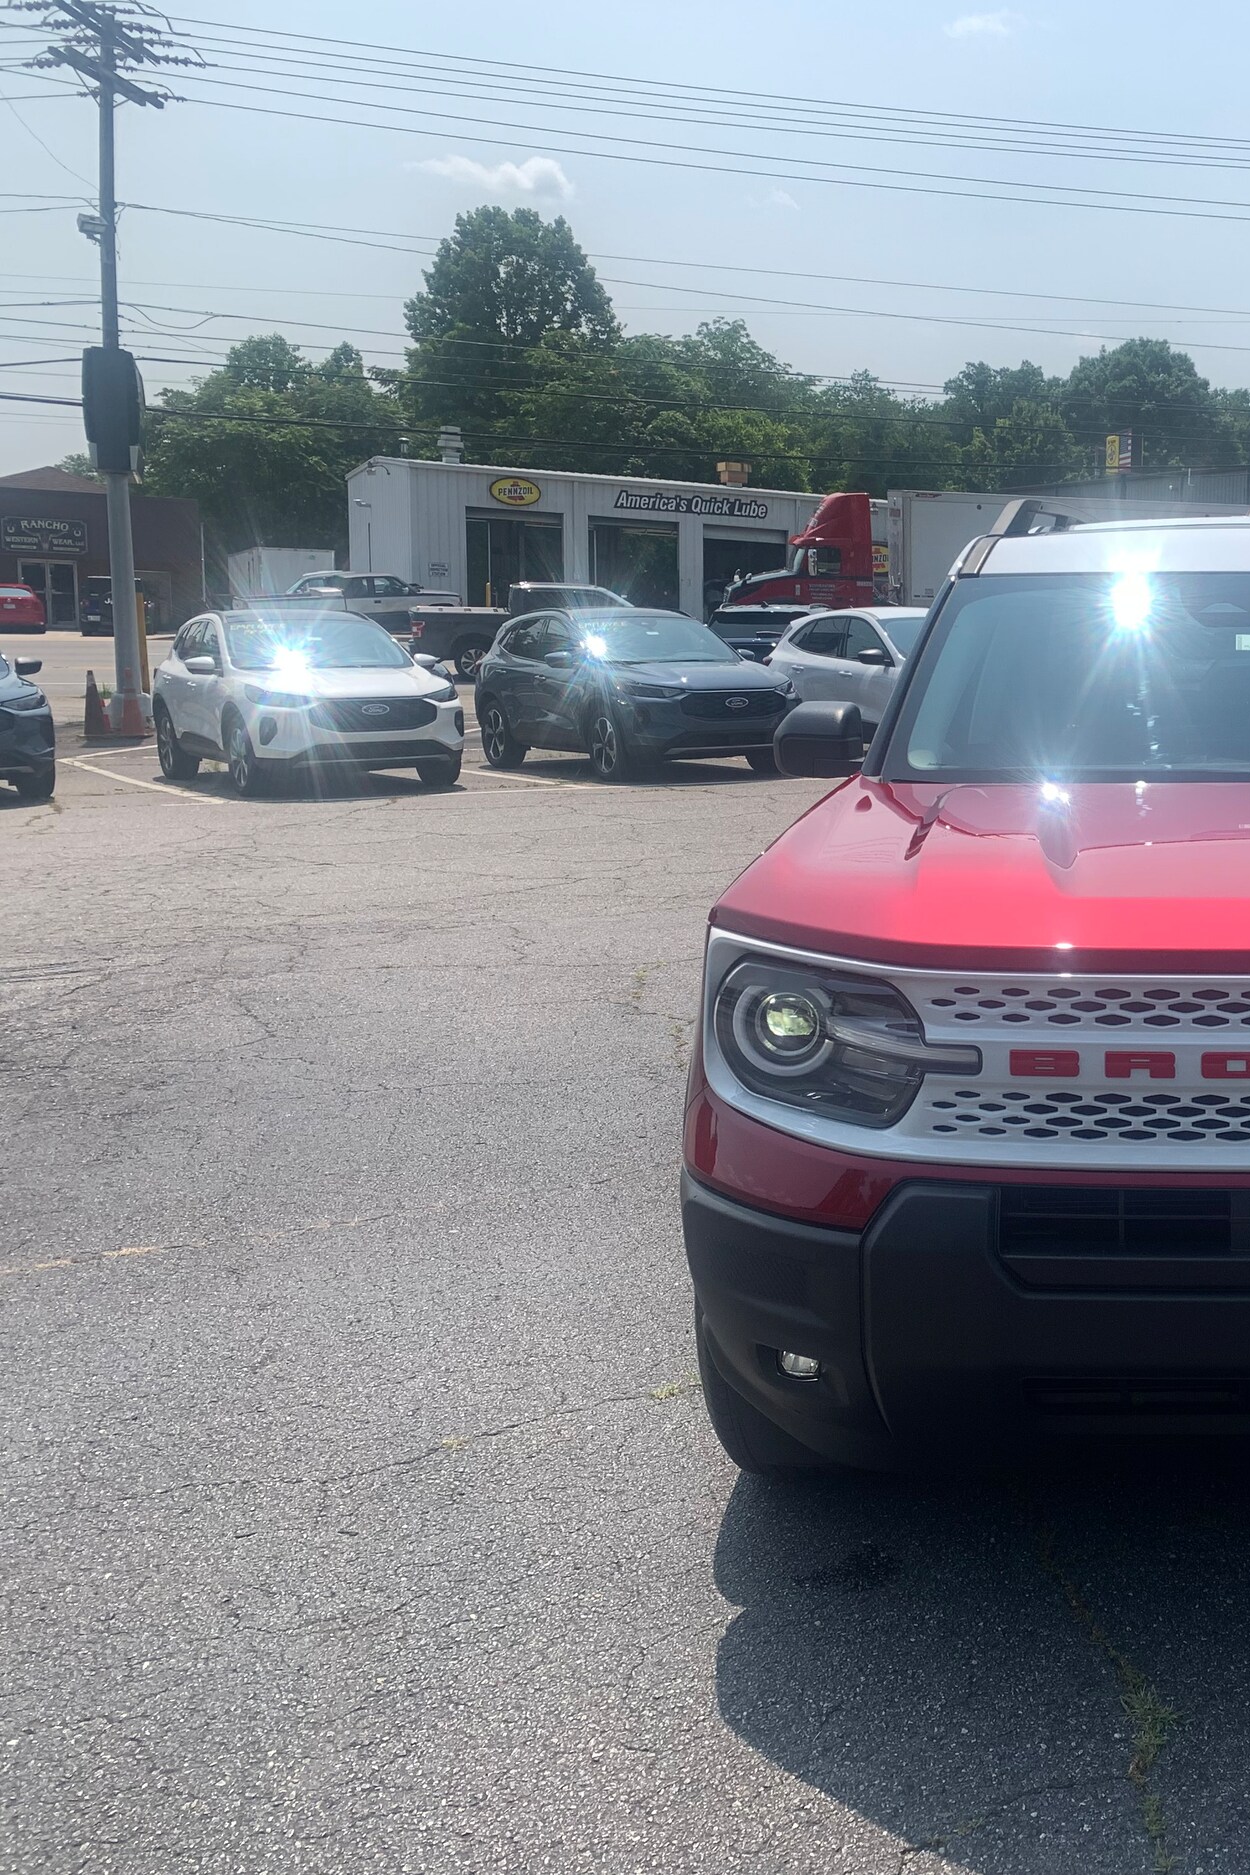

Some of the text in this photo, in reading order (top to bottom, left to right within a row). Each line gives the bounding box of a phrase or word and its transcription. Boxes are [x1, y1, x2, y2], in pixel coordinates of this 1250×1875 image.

[497, 486, 534, 496] PENNZOIL
[616, 491, 767, 518] America's Quick Lube
[20, 520, 69, 532] RANCHO
[4, 536, 39, 544] WESTERN
